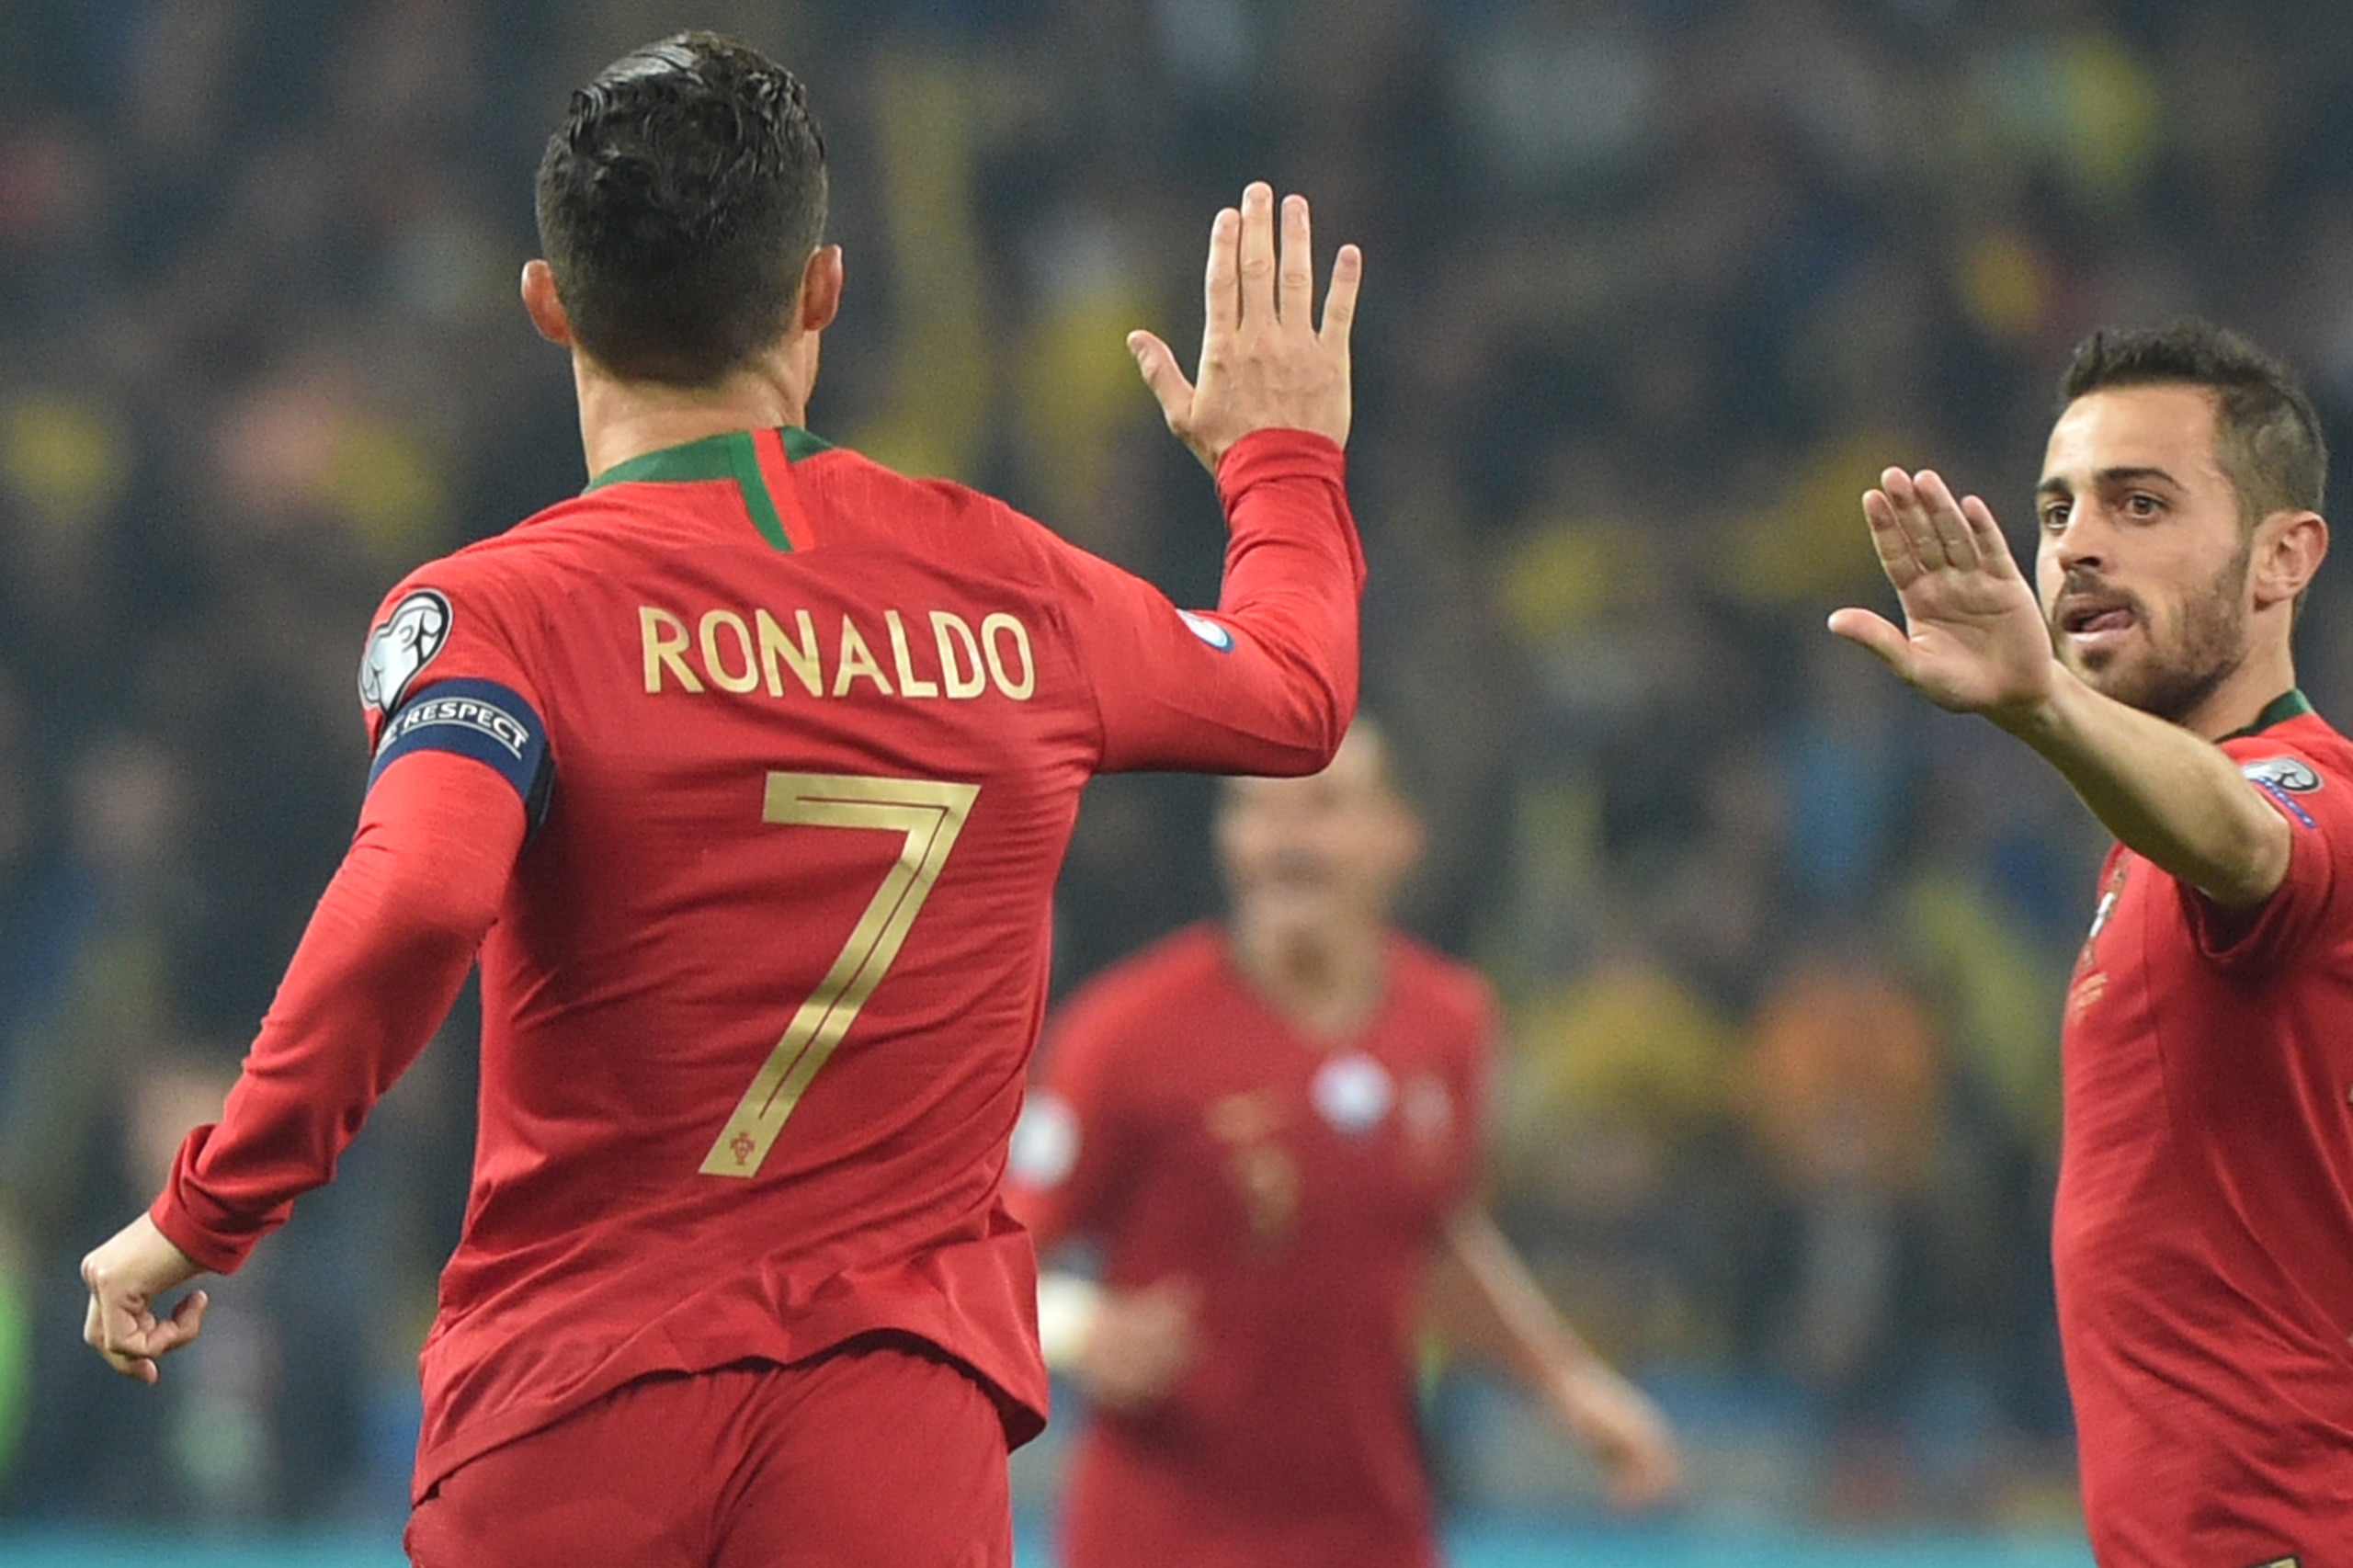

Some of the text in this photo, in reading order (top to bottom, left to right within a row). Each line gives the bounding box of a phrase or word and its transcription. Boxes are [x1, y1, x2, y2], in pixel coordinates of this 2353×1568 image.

[640, 607, 1036, 701] RONALDO
[404, 701, 528, 751] RESPECT
[699, 772, 981, 1177] 7
